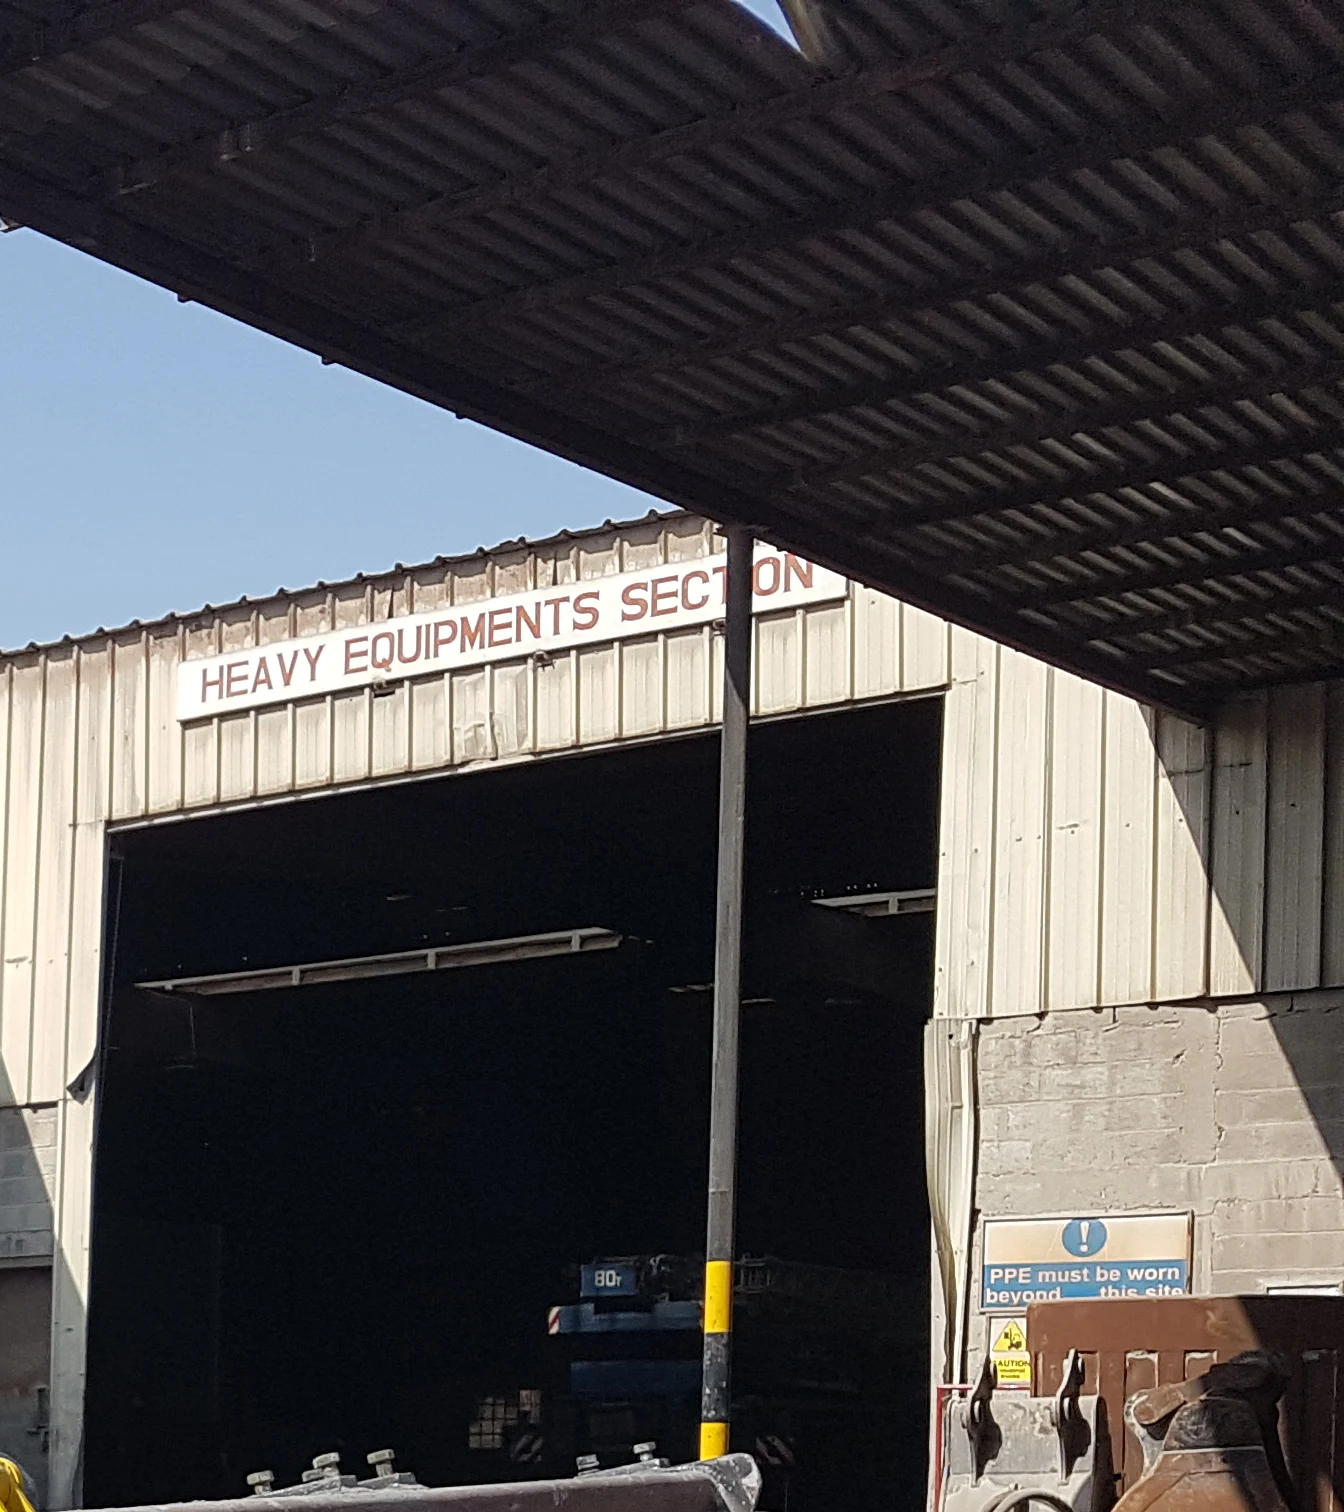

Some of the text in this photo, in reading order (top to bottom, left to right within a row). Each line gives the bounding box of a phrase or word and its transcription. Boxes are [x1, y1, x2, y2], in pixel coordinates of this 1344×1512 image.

[201, 552, 814, 702] HEAVY EQUIPMENTS SECTON
[990, 1266, 1180, 1284] PPE must be worn
[986, 1284, 1184, 1303] beyond this site
[993, 1359, 1028, 1367] AUTIO
